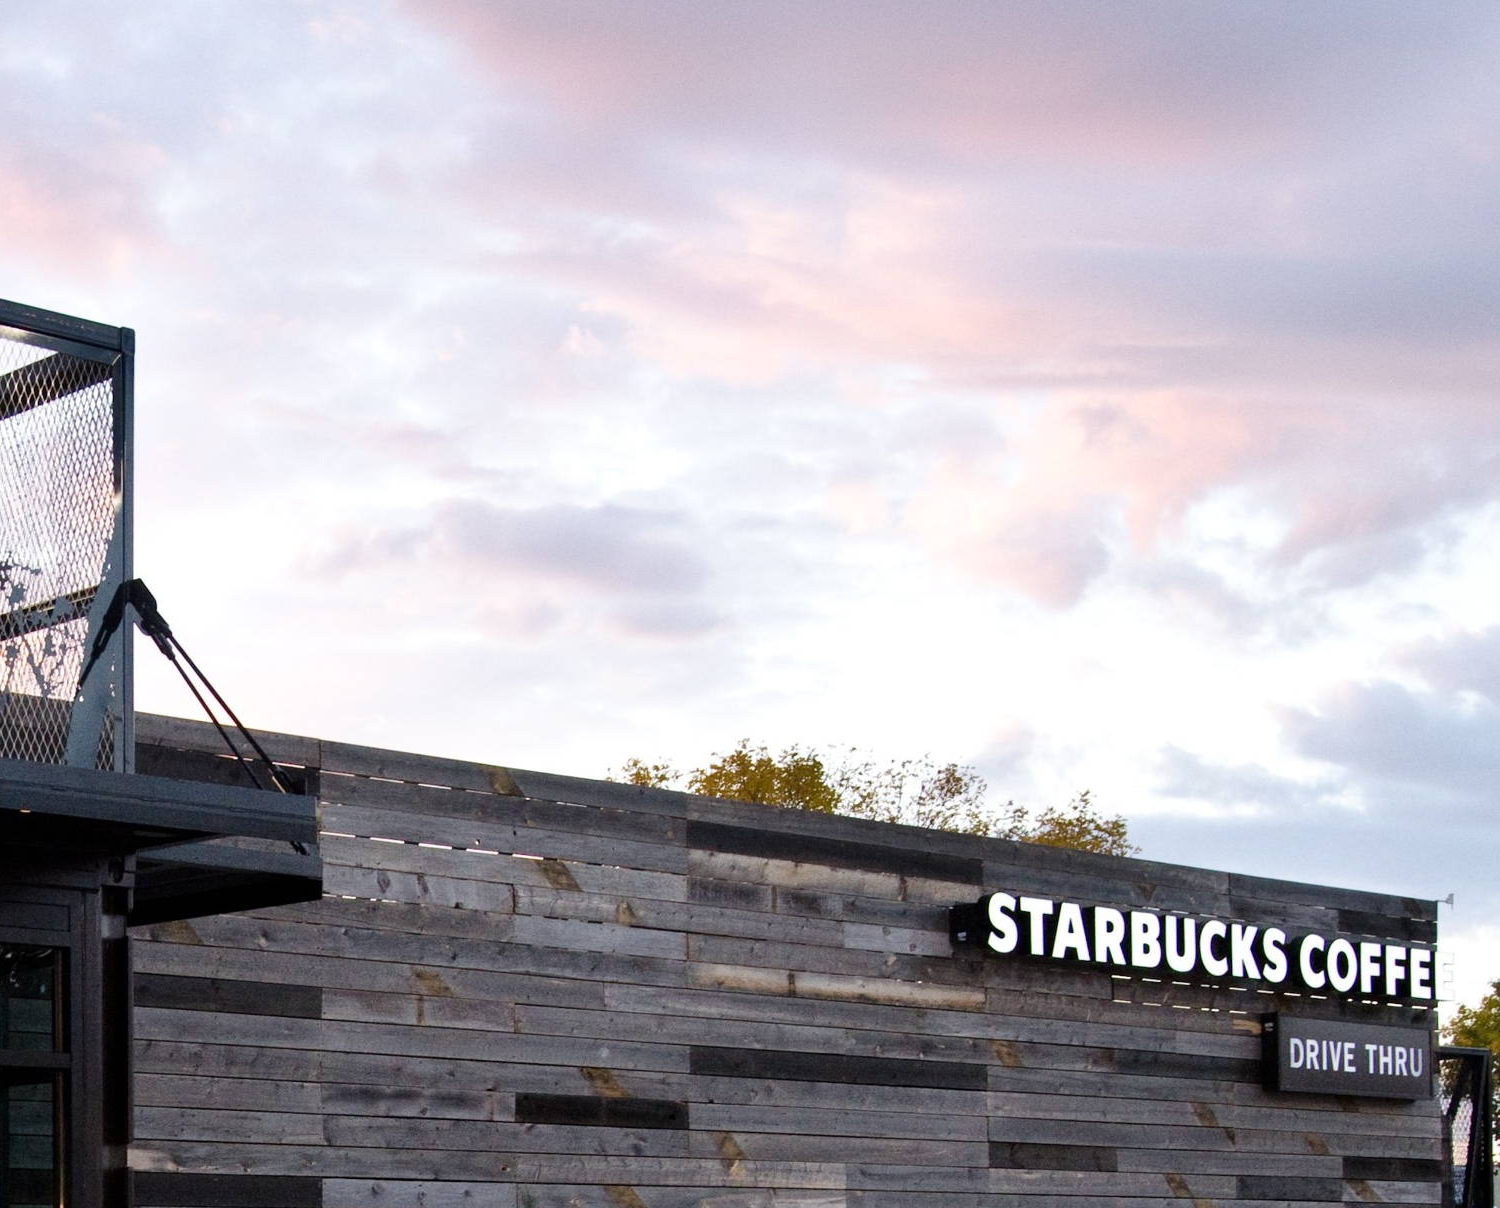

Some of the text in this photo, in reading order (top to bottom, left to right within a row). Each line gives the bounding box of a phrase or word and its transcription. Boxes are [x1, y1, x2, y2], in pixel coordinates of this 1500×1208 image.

[988, 892, 1288, 983] STARBUCKS
[1289, 1037, 1423, 1078] DRIVE THRU
